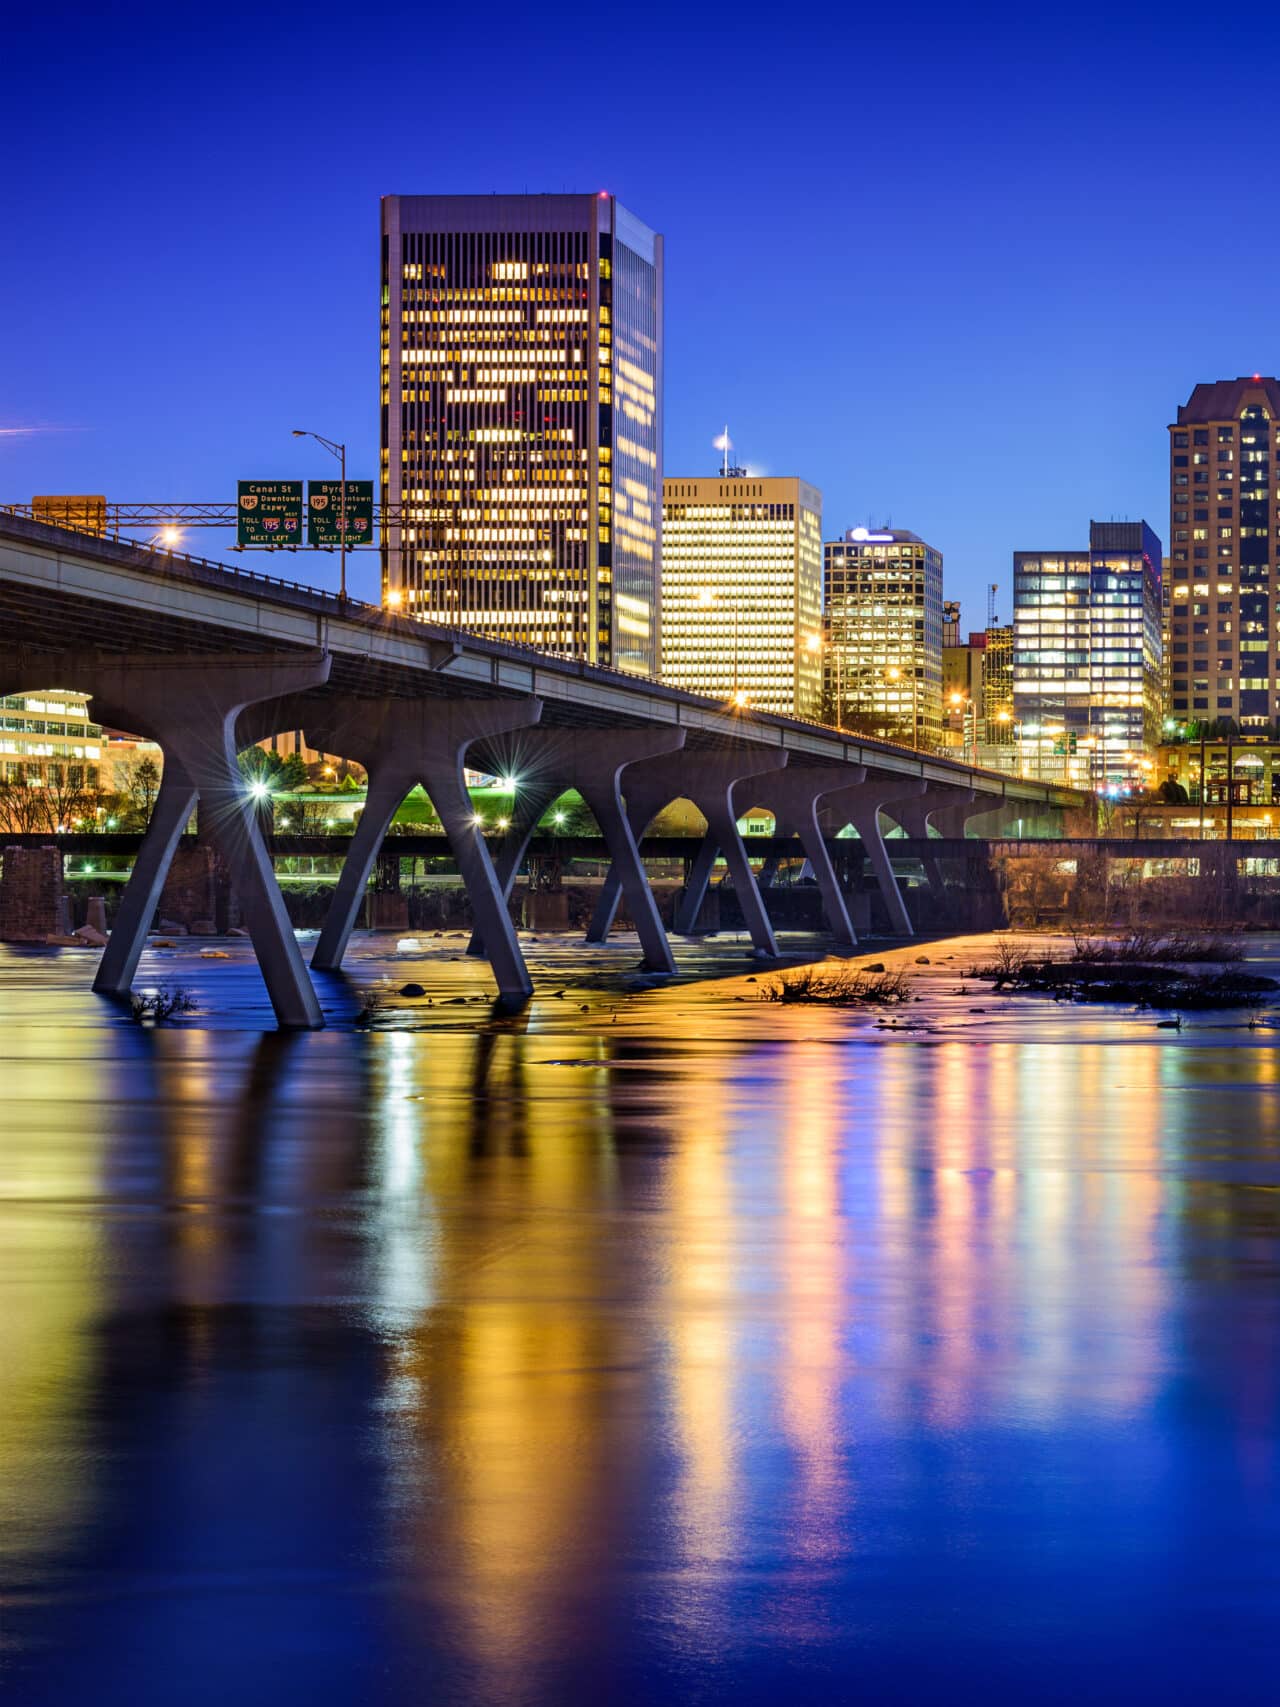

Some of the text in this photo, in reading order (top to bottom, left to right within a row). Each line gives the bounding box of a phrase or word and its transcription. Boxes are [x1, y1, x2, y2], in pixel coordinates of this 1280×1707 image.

[249, 485, 292, 493] Canal St
[349, 485, 359, 493] St
[243, 498, 256, 507] 195
[313, 498, 326, 507] 195
[331, 504, 357, 512] Exwy
[265, 521, 279, 530] 195
[285, 521, 297, 531] 64
[354, 521, 368, 531] 95
